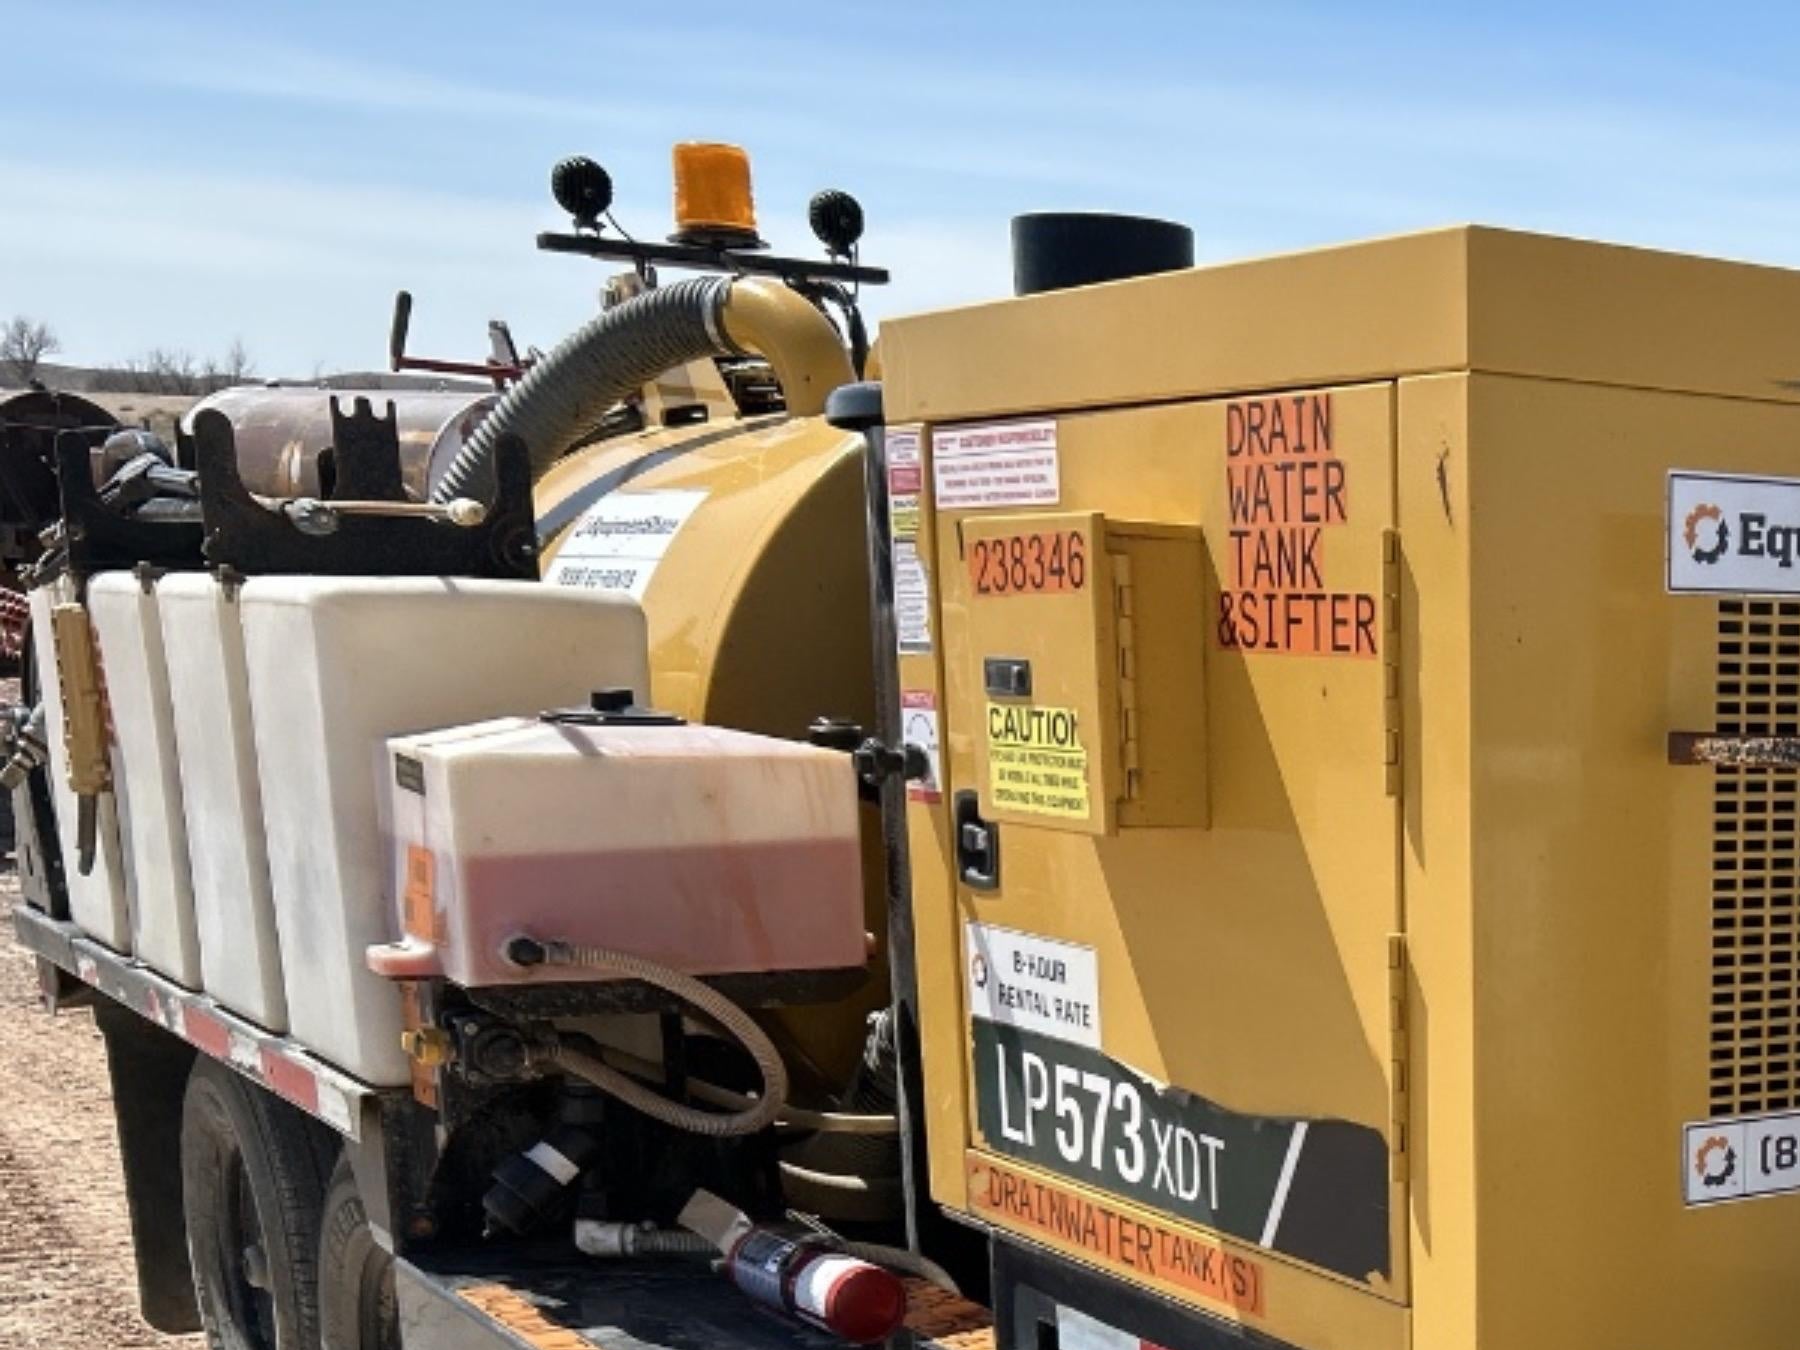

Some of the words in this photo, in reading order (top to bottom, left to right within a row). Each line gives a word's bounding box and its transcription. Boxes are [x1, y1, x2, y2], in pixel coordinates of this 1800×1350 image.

[1227, 394, 1331, 457] DRAIN
[1227, 460, 1347, 523] WATER
[975, 530, 1083, 593] 238346
[1229, 528, 1323, 588] TANK
[1217, 591, 1377, 655] &SIFTER
[998, 982, 1051, 1018] RENTAL
[1055, 998, 1091, 1027] RATE
